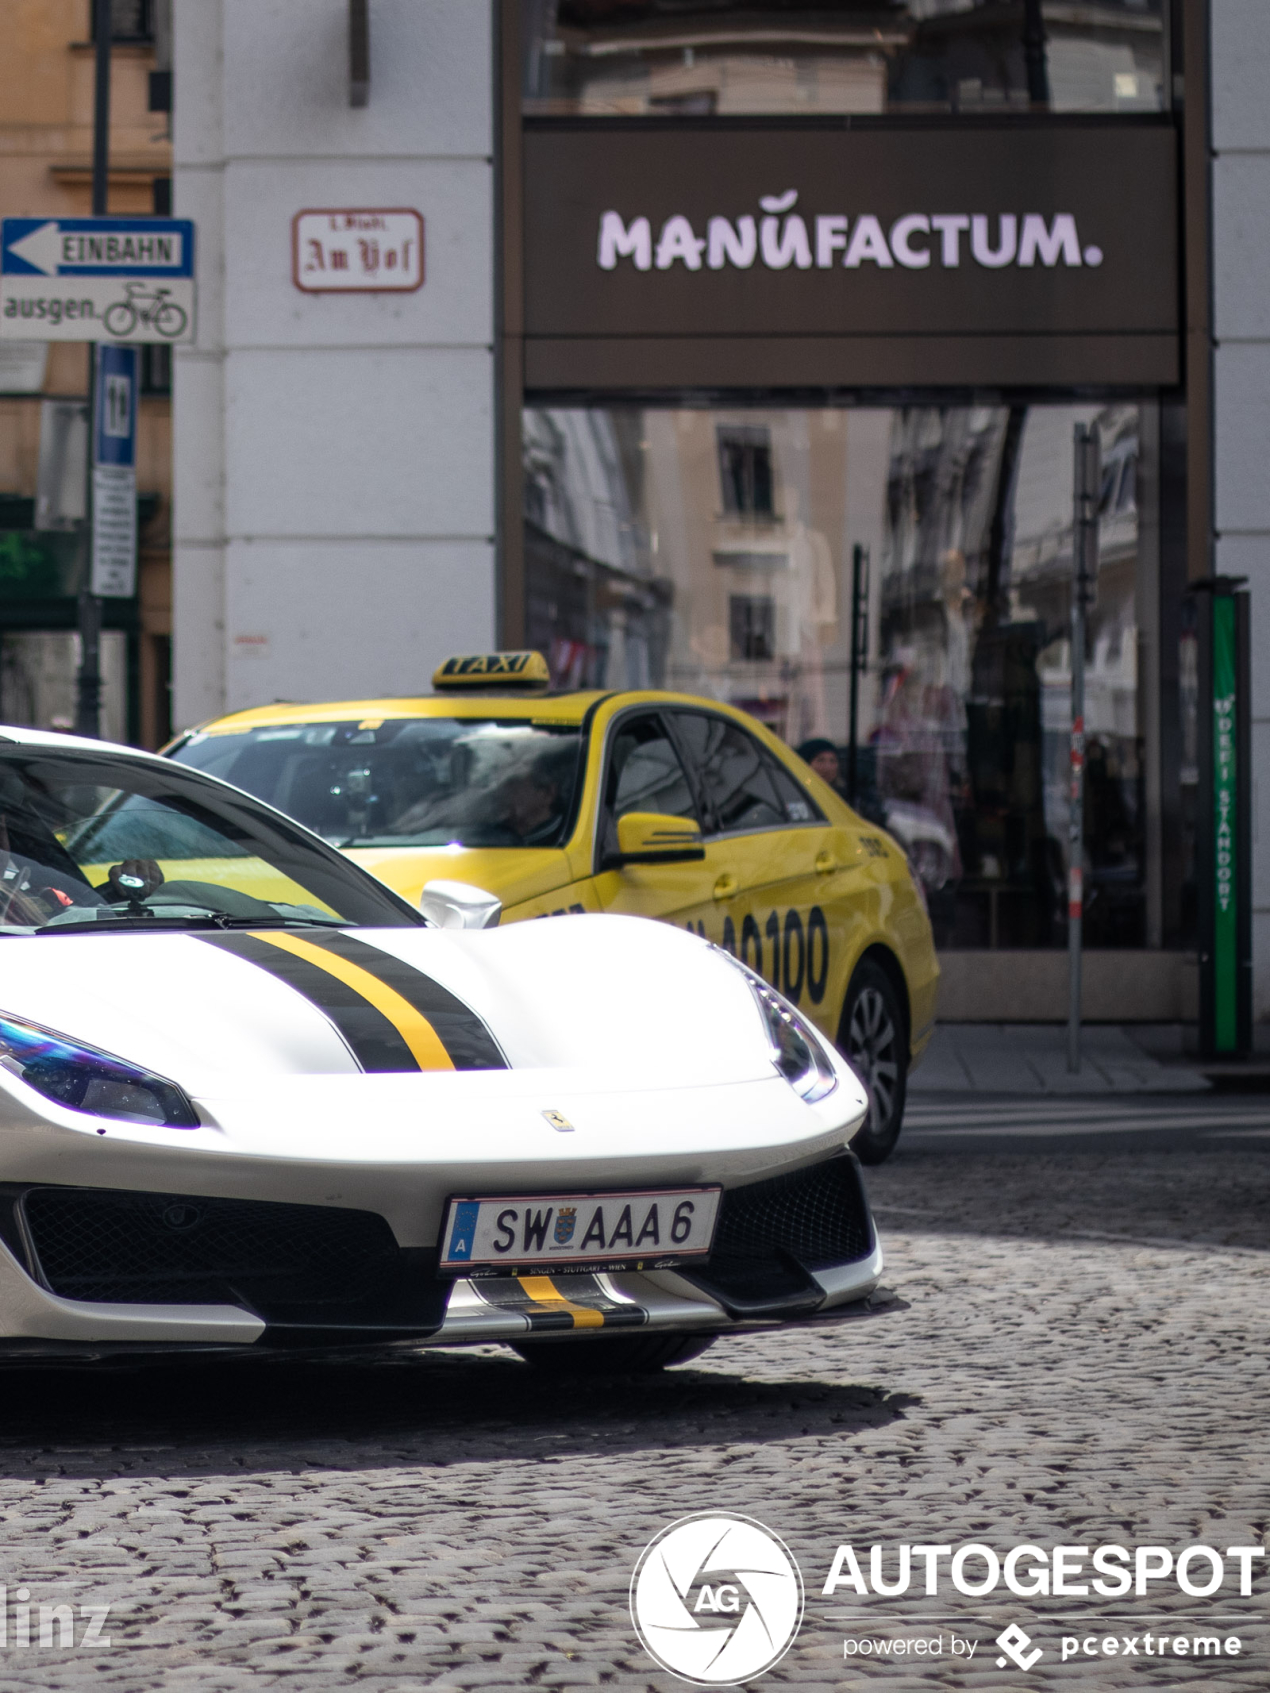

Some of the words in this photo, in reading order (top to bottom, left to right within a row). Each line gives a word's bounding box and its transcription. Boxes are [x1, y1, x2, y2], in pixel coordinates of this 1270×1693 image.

[63, 236, 172, 262] EINBAHN
[4, 299, 102, 325] ausgen.
[449, 655, 527, 674] TAXI
[1217, 790, 1232, 913] STANDORT
[493, 1207, 553, 1253] SW
[455, 1239, 466, 1253] A
[563, 1265, 601, 1274] STUTTGART
[608, 1263, 627, 1271] WIEN
